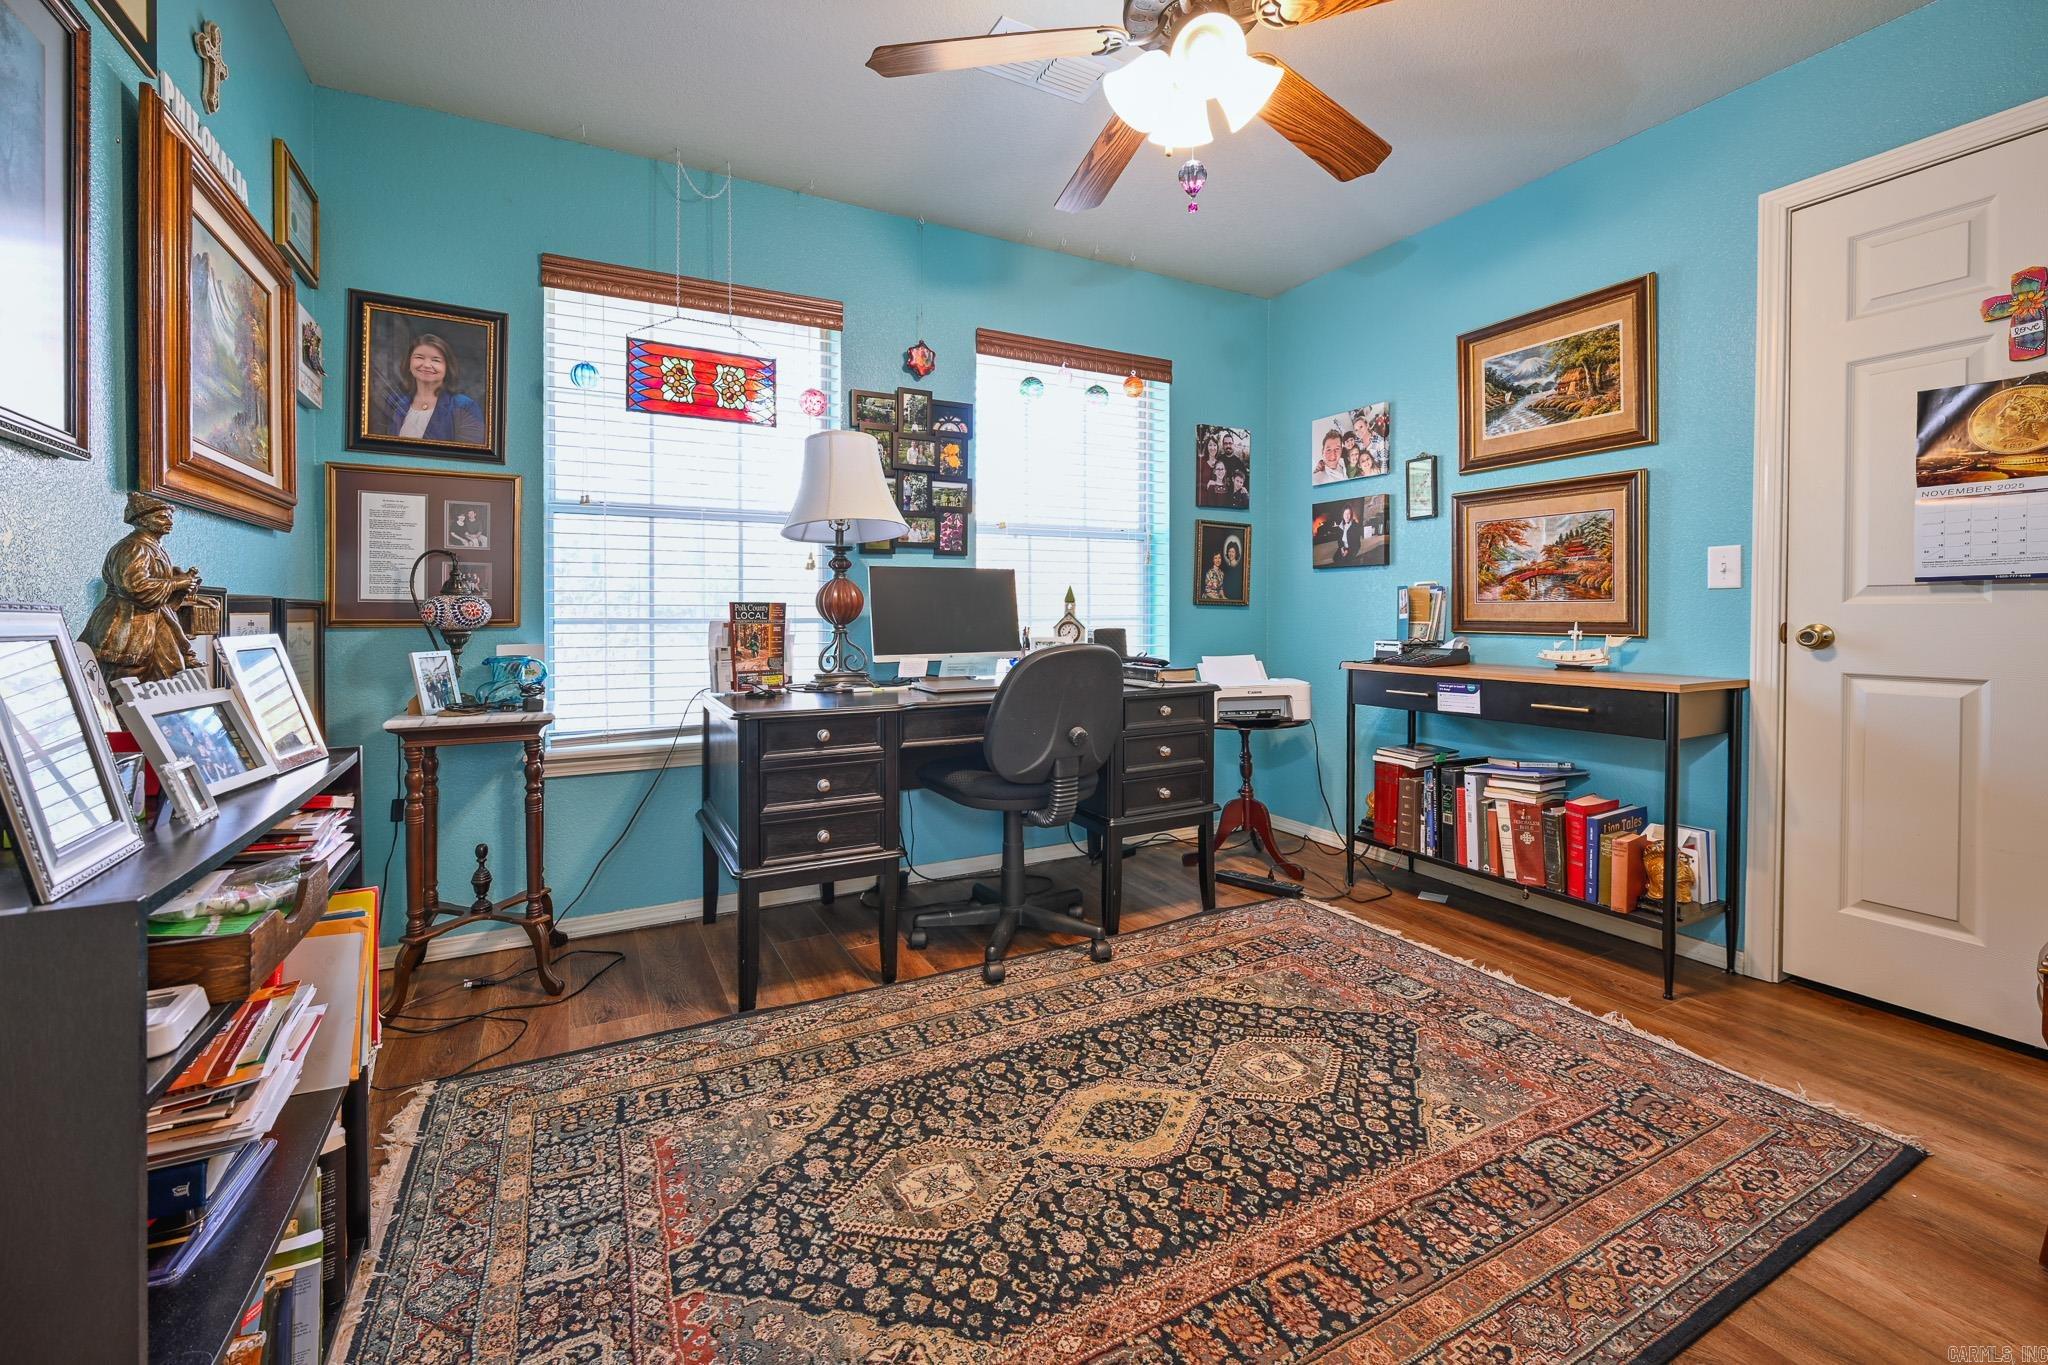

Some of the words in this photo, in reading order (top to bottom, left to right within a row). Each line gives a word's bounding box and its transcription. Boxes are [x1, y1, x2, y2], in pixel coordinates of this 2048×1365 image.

[160, 70, 249, 207] PHILOKALIA
[2014, 322, 2041, 335] love
[1921, 485, 1992, 498] NOVEMBER
[1996, 482, 2025, 491] 2025
[734, 603, 748, 612] Polk
[747, 603, 769, 614] County
[735, 611, 768, 620] LOCAL
[121, 667, 211, 701] Family
[1621, 816, 1643, 830] Tales
